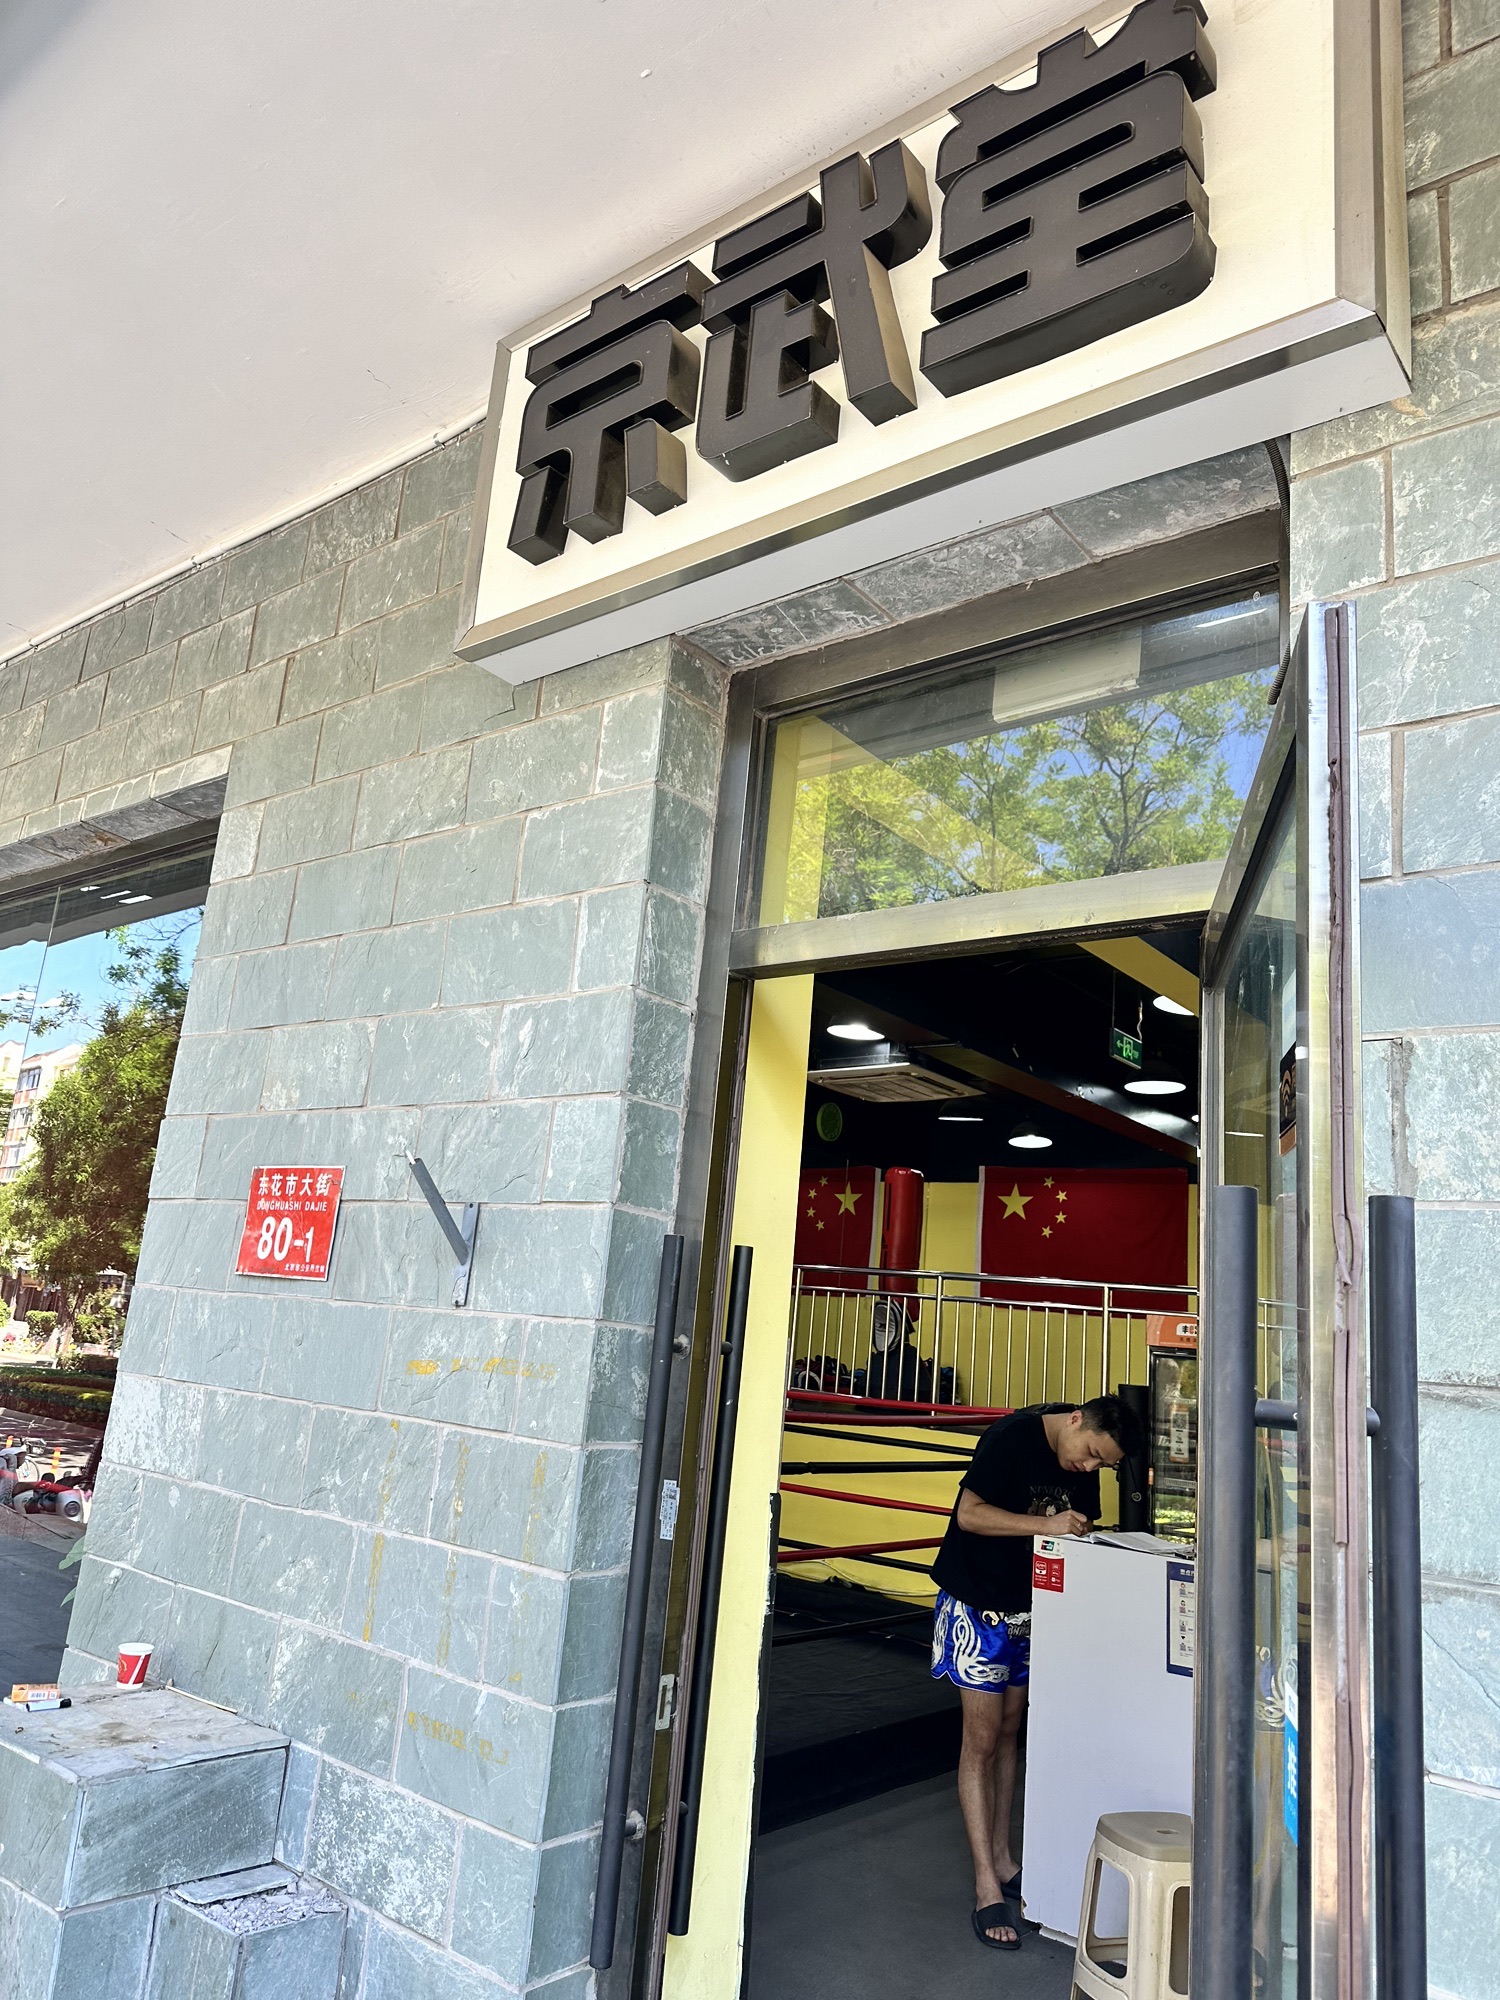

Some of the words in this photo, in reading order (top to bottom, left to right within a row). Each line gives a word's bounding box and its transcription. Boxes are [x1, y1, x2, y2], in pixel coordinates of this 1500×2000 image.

[257, 1173, 332, 1197] 东花市大街
[256, 1200, 302, 1211] DONGHUASHI
[304, 1201, 327, 1212] DAJIE
[257, 1216, 314, 1263] 80-1
